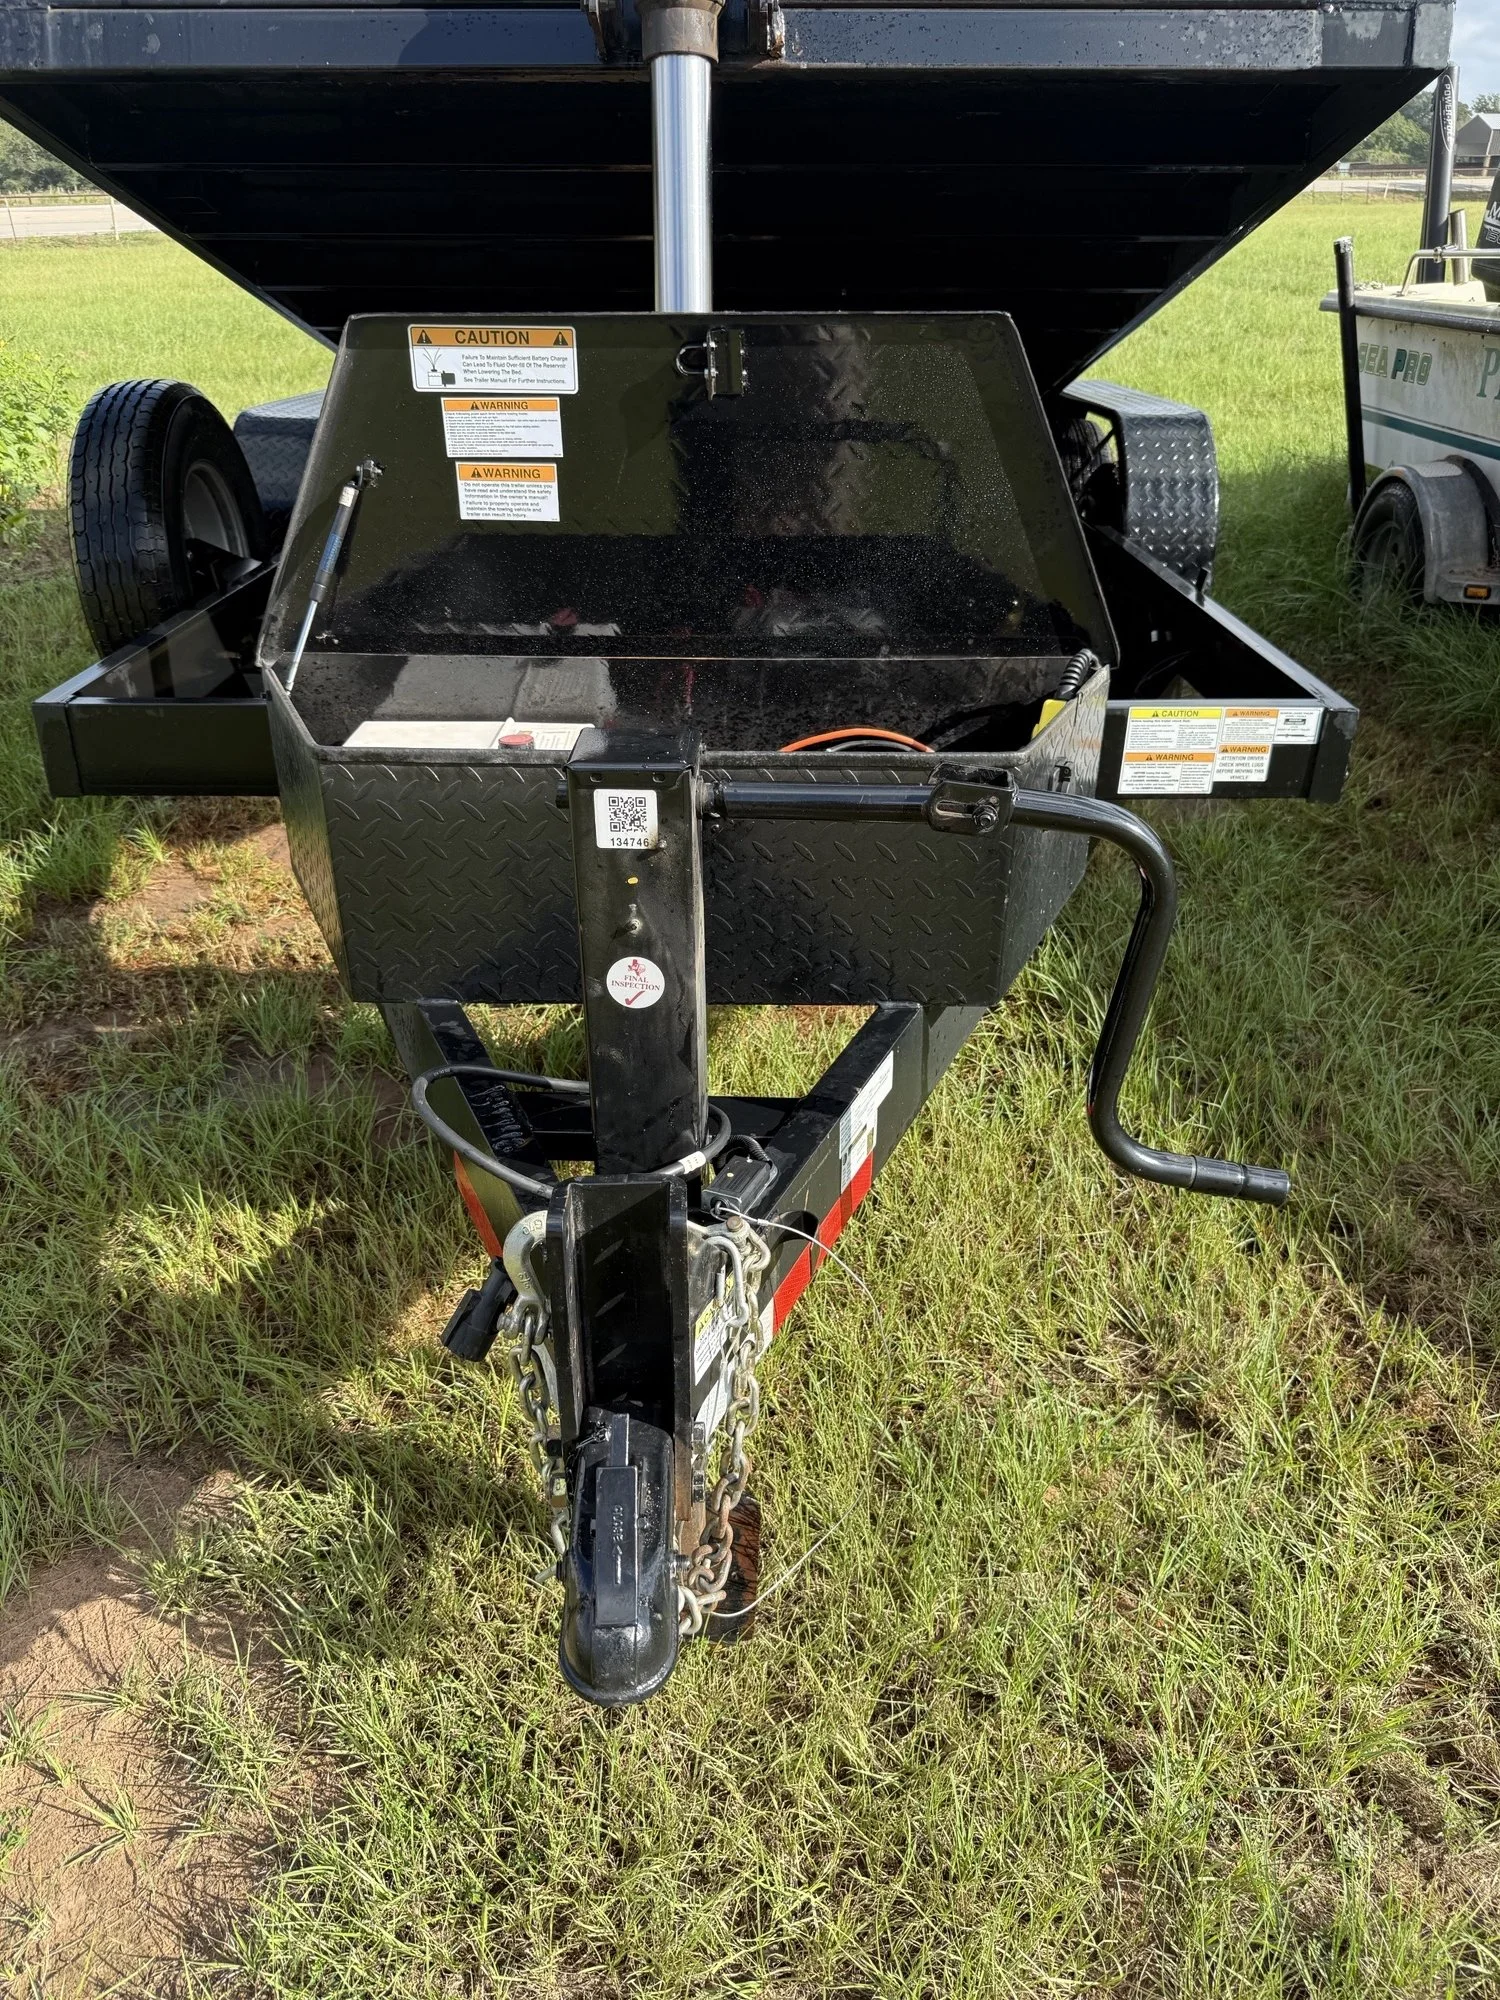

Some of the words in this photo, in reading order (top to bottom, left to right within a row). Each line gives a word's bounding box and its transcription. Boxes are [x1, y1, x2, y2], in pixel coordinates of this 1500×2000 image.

[455, 330, 529, 344] CAUTION
[1391, 348, 1432, 386] PRO
[480, 402, 528, 410] WARNING
[483, 468, 540, 478] WARNING
[611, 838, 650, 847] 134746
[624, 975, 648, 983] FINAL
[612, 980, 660, 990] INSPECTION
